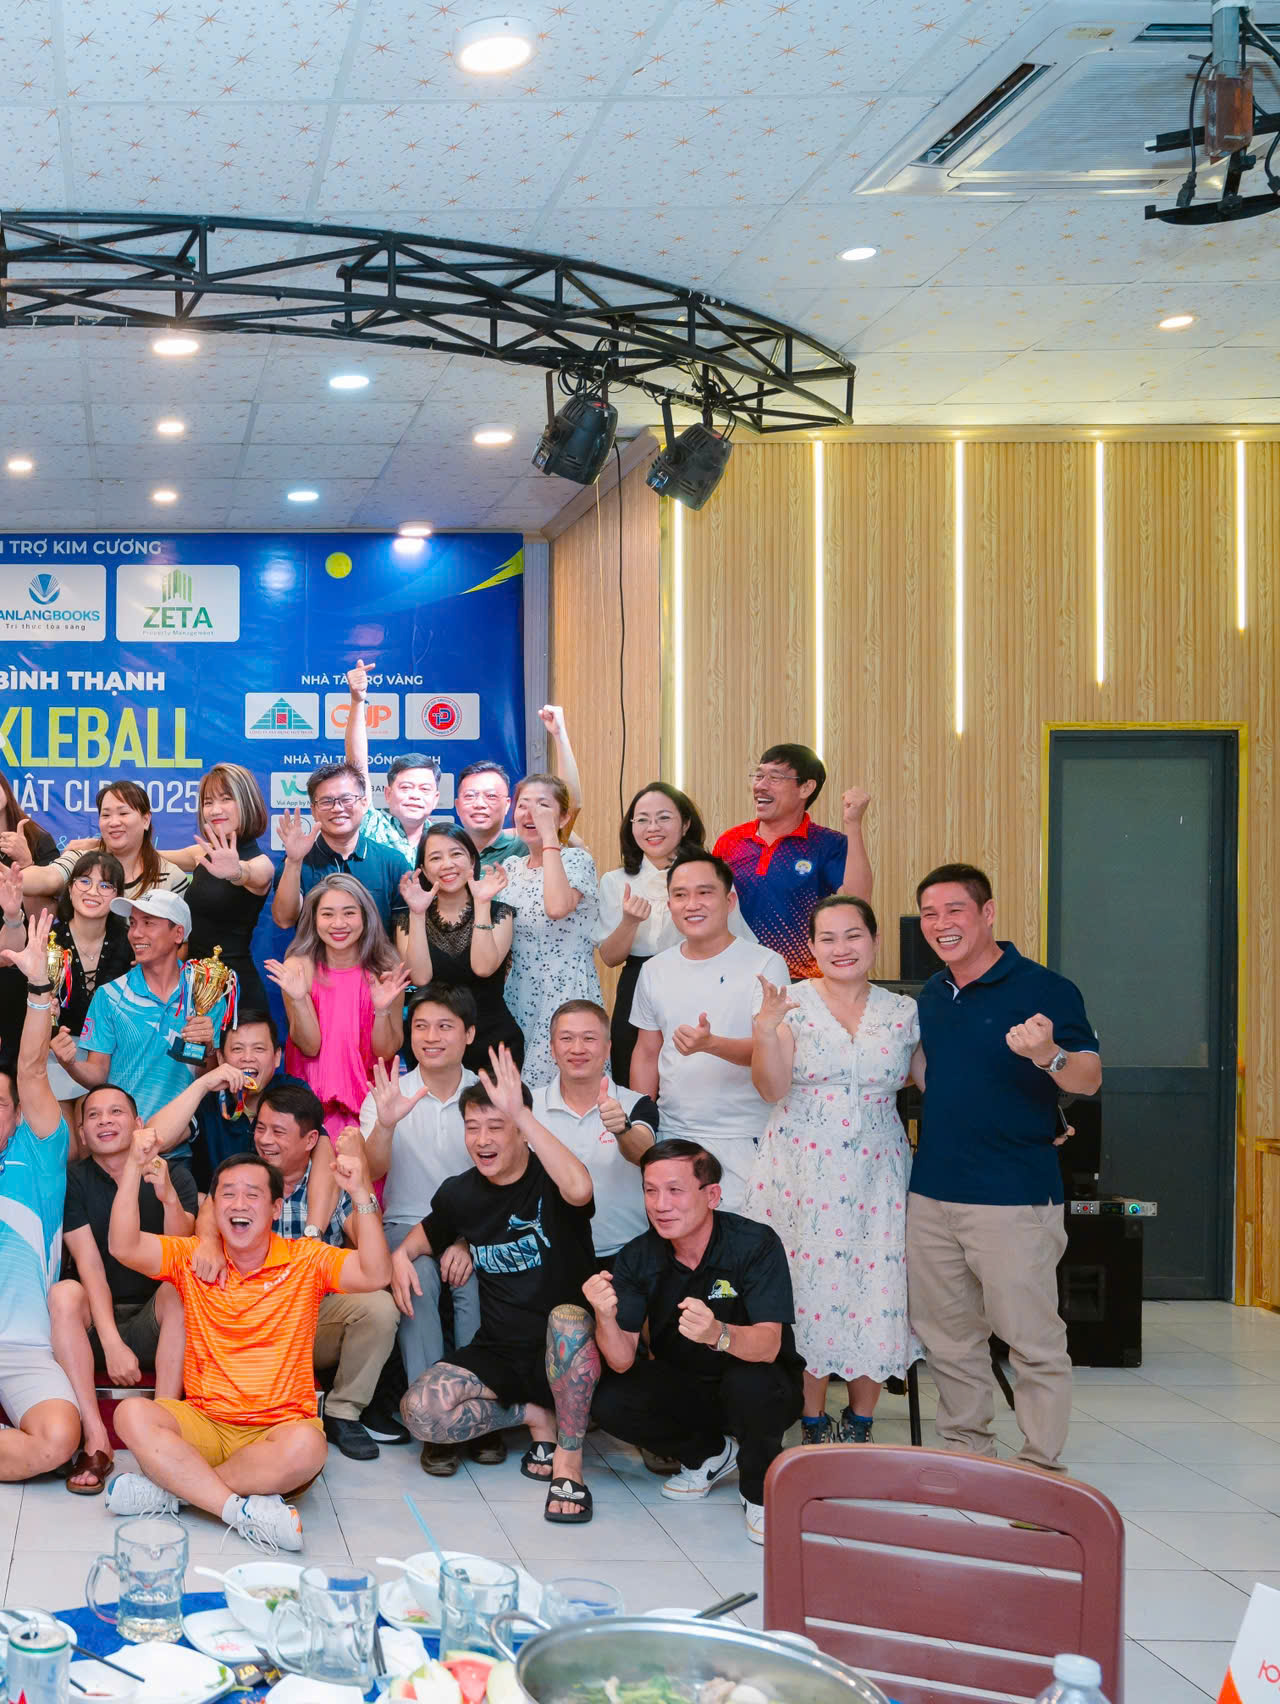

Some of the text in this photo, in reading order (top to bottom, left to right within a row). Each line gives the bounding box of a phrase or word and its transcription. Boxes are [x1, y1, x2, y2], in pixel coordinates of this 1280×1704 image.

[9, 538, 48, 557] TRỢ
[53, 540, 87, 554] KIM
[93, 538, 162, 554] CƯƠNG
[143, 606, 213, 629] ZETA
[67, 671, 165, 697] THẠNH
[301, 672, 424, 687] NHÀ TÀ RỢ VÀNG
[283, 753, 311, 764] NHÀ
[313, 753, 333, 764] TÀI
[12, 772, 55, 818] ẬT
[65, 780, 113, 812] CL
[135, 780, 200, 813] 025
